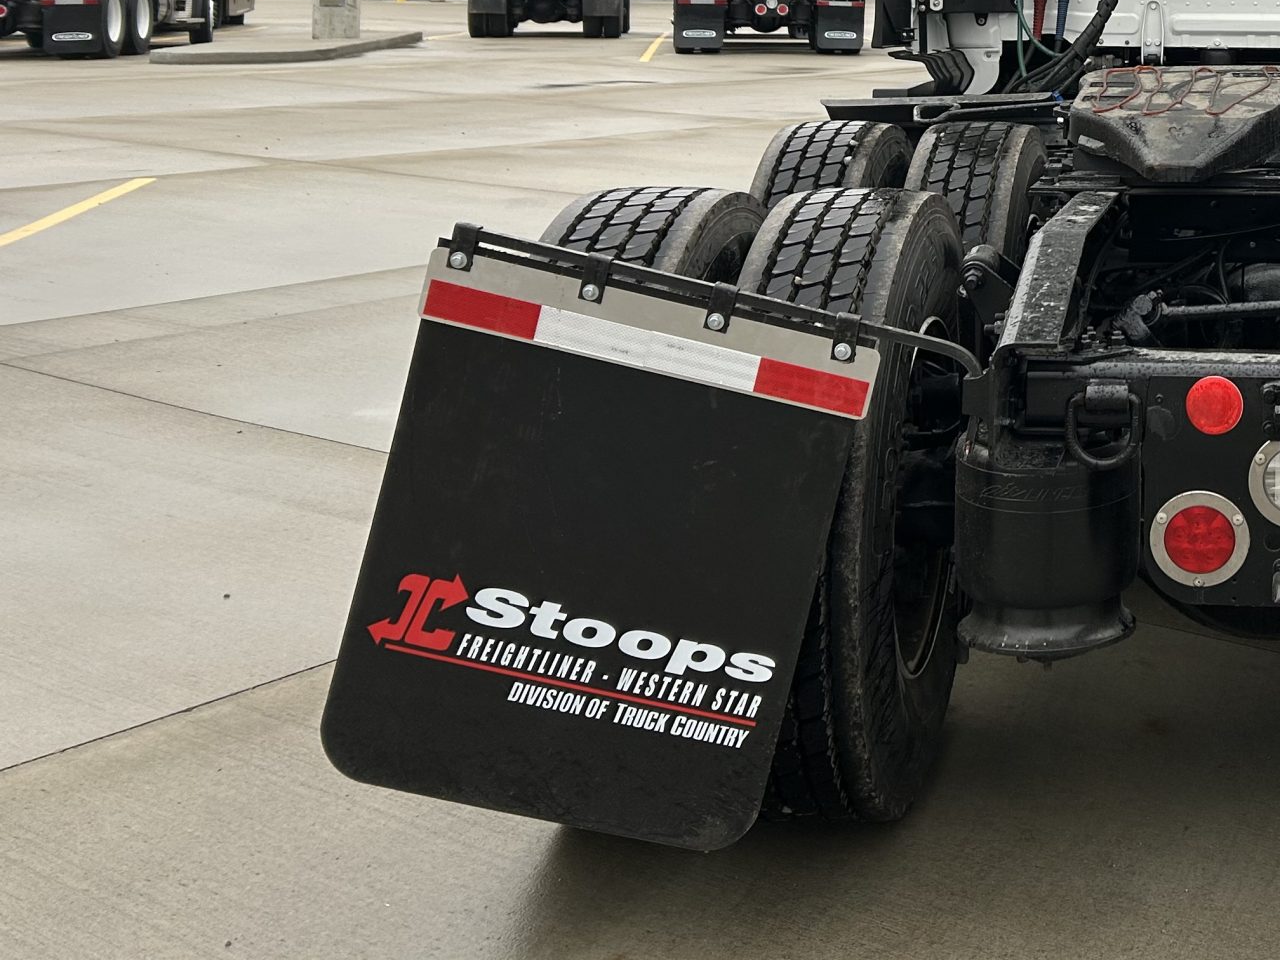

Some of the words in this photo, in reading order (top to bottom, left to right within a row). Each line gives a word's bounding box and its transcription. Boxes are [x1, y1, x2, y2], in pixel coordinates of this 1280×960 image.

[455, 633, 597, 684] FREIGHTLINER
[615, 667, 709, 707] WESTERN
[711, 687, 763, 719] STAR
[465, 587, 776, 683] Stoops
[507, 681, 587, 715] DIVISION
[584, 698, 611, 720] OF
[612, 702, 671, 733] TRUCK
[669, 715, 750, 749] COUNTRY
